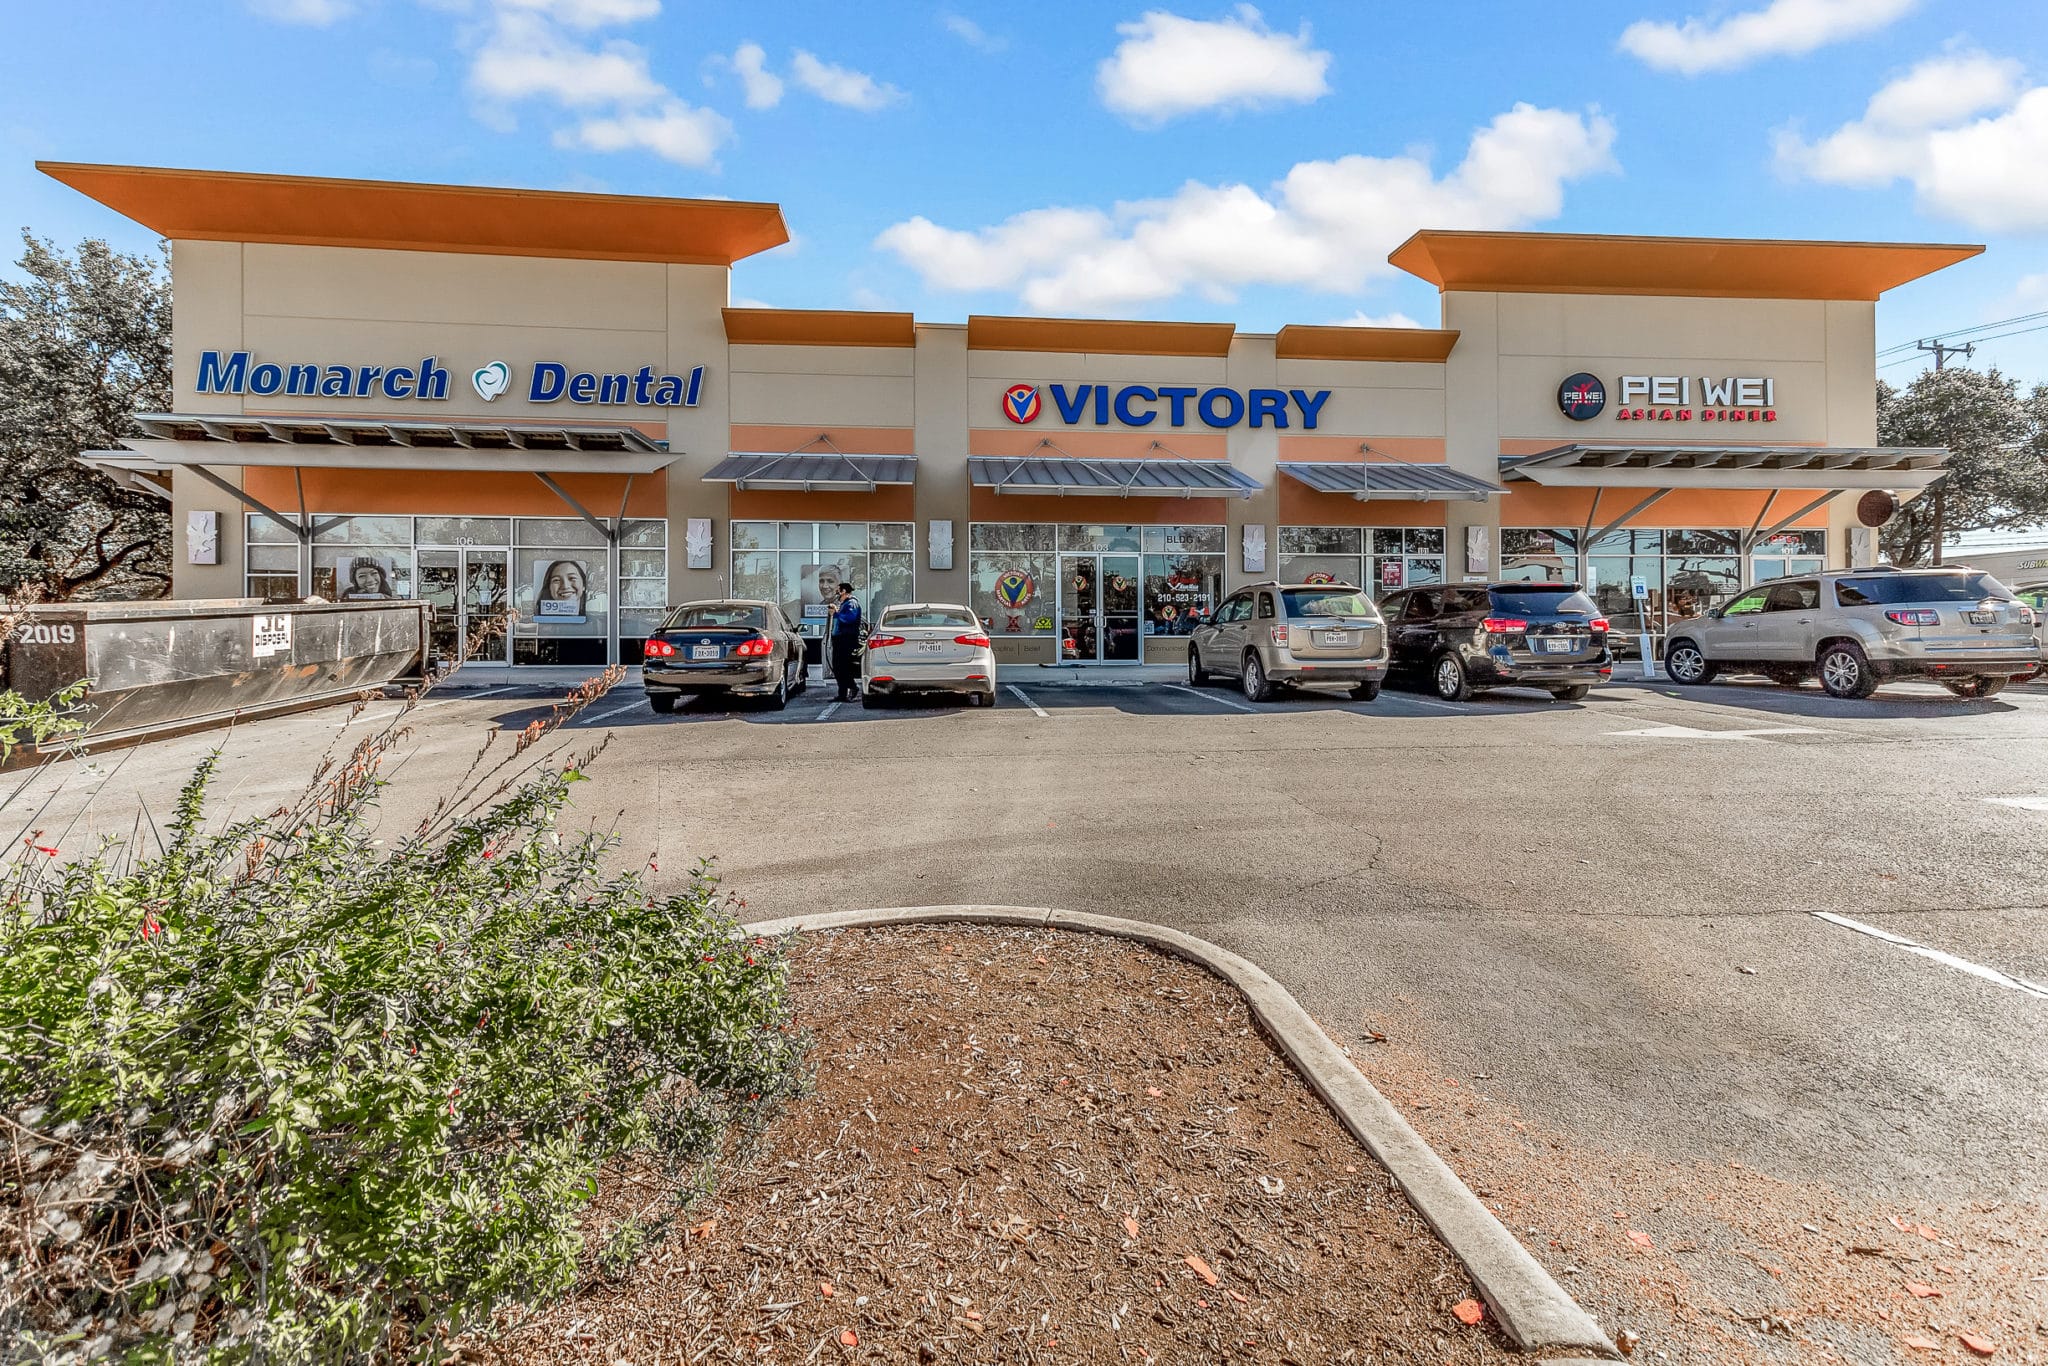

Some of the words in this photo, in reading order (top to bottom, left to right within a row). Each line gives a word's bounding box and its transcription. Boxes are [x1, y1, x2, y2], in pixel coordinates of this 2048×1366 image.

[195, 350, 452, 401] Monarch
[528, 361, 706, 408] Dental
[1564, 392, 1582, 400] PEI
[1584, 392, 1603, 400] WEI
[1618, 376, 1690, 405] PEI
[1699, 377, 1774, 406] WEI
[1049, 384, 1332, 430] VICTORY
[1616, 409, 1692, 421] ASIAN
[1701, 410, 1777, 422] DINER
[455, 537, 474, 546] 106
[1166, 536, 1194, 544] BLDG
[1157, 593, 1210, 602] 210-523-2191
[262, 615, 285, 632] JC
[18, 624, 76, 644] 2019
[256, 633, 289, 646] DISPOSAL
